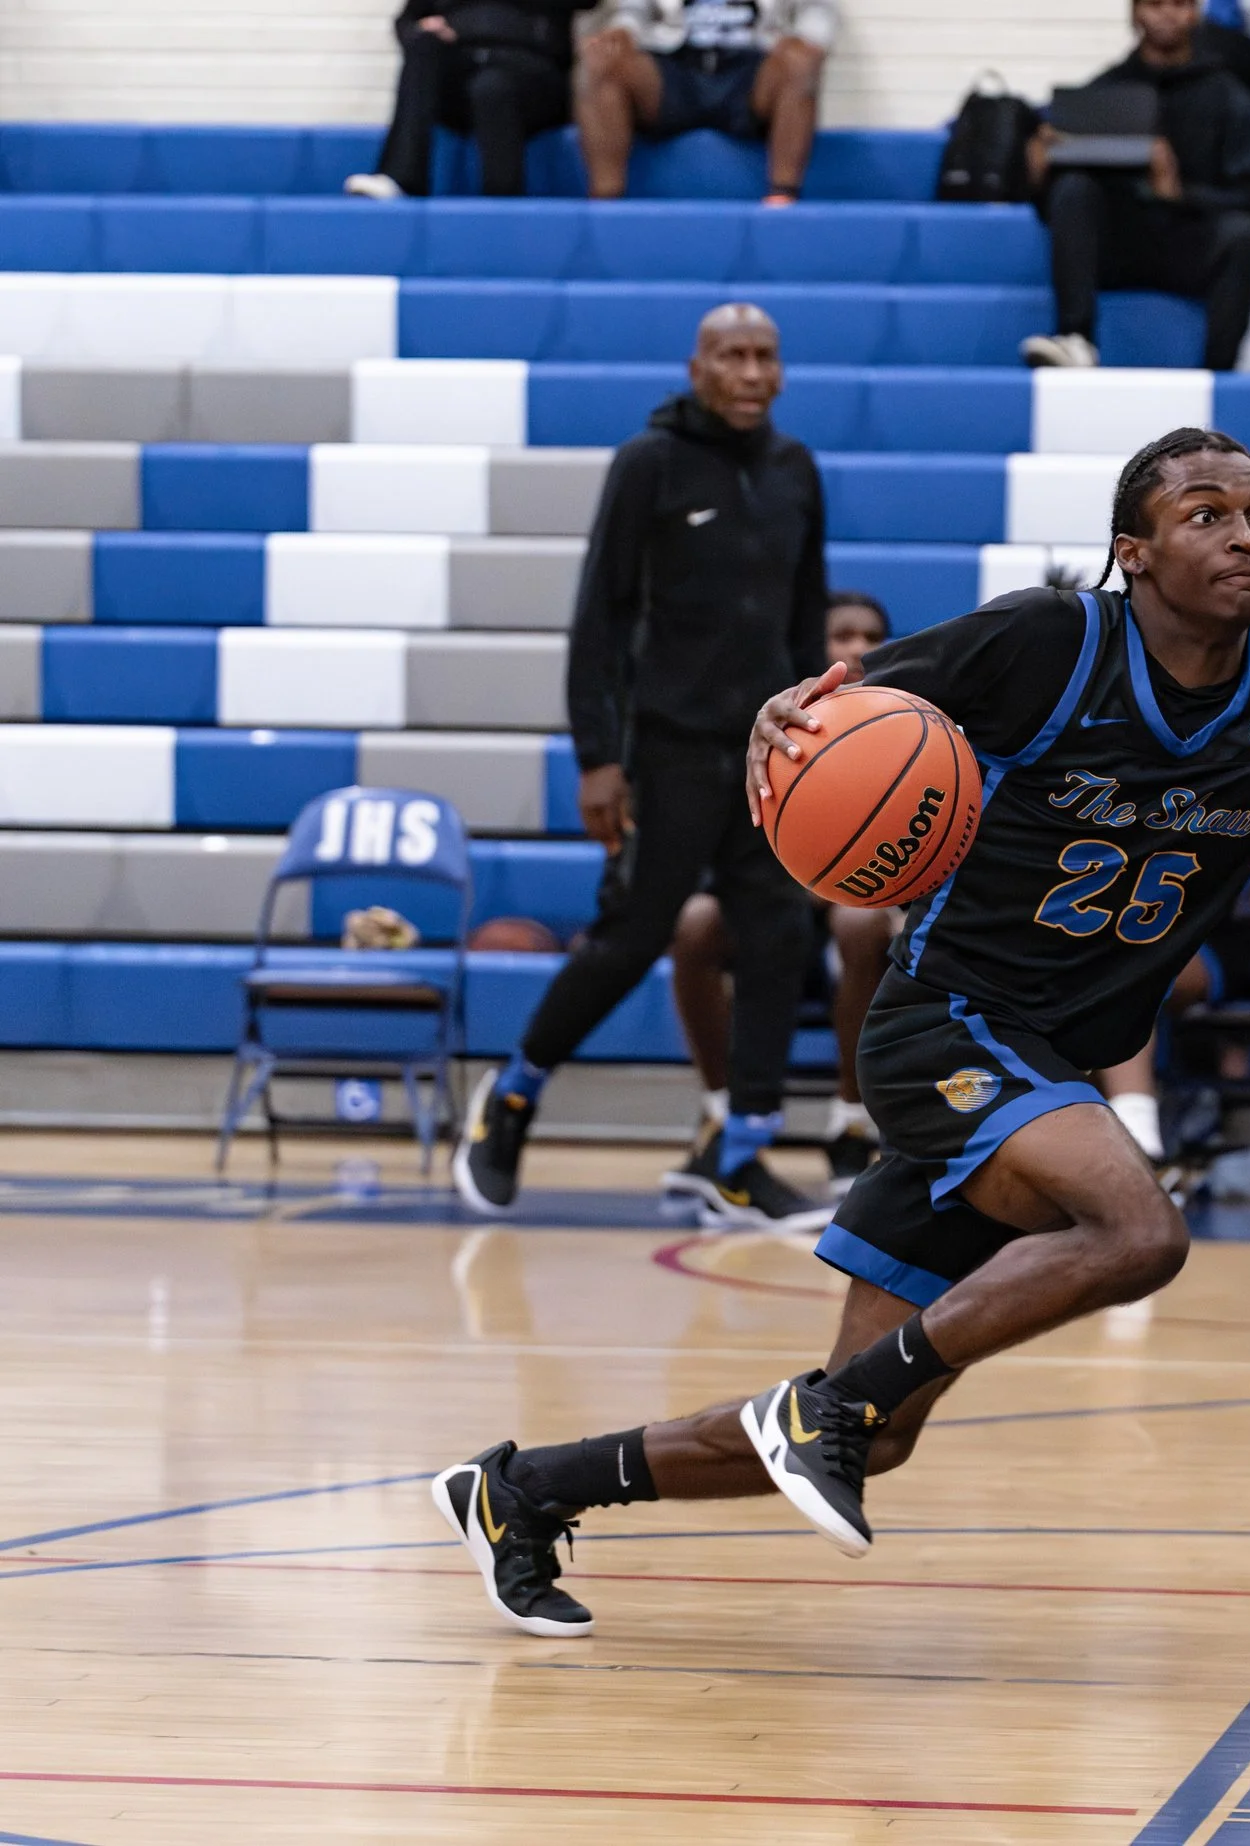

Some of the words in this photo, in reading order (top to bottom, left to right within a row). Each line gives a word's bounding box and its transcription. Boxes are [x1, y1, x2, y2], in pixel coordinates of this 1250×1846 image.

[314, 798, 441, 867] JHS
[833, 784, 947, 899] Wilson
[1048, 769, 1138, 828] The
[1033, 838, 1203, 944] 25
